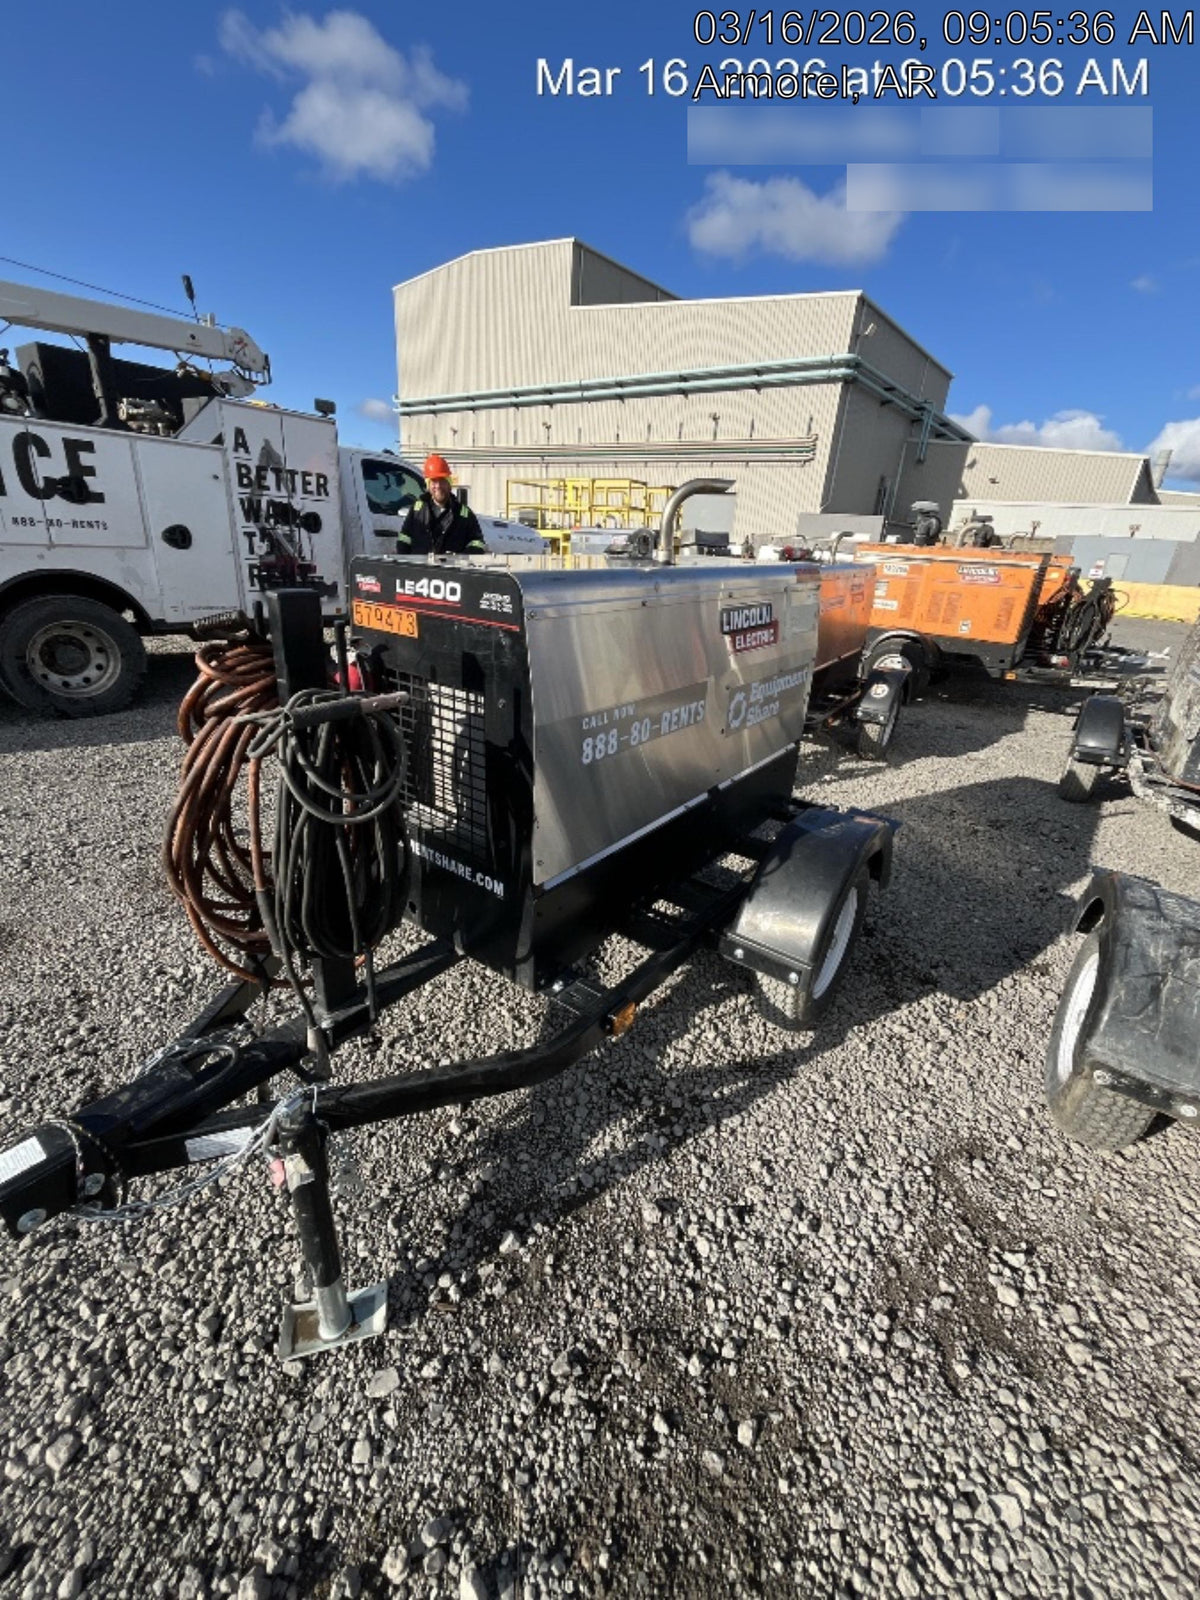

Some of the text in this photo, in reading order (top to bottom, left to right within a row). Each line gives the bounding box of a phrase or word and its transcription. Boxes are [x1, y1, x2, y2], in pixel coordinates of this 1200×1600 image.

[234, 426, 250, 454] A
[0, 431, 105, 504] CE
[236, 462, 330, 498] BETTER
[396, 578, 462, 602] LE400
[355, 604, 415, 635] 579473
[722, 605, 771, 632] LINCOLN
[735, 629, 774, 649] ELECTRIC
[750, 667, 808, 702] Equipment
[582, 704, 636, 730] CALL NOW
[746, 700, 780, 727] Share
[582, 700, 706, 765] 888-80-RENTS
